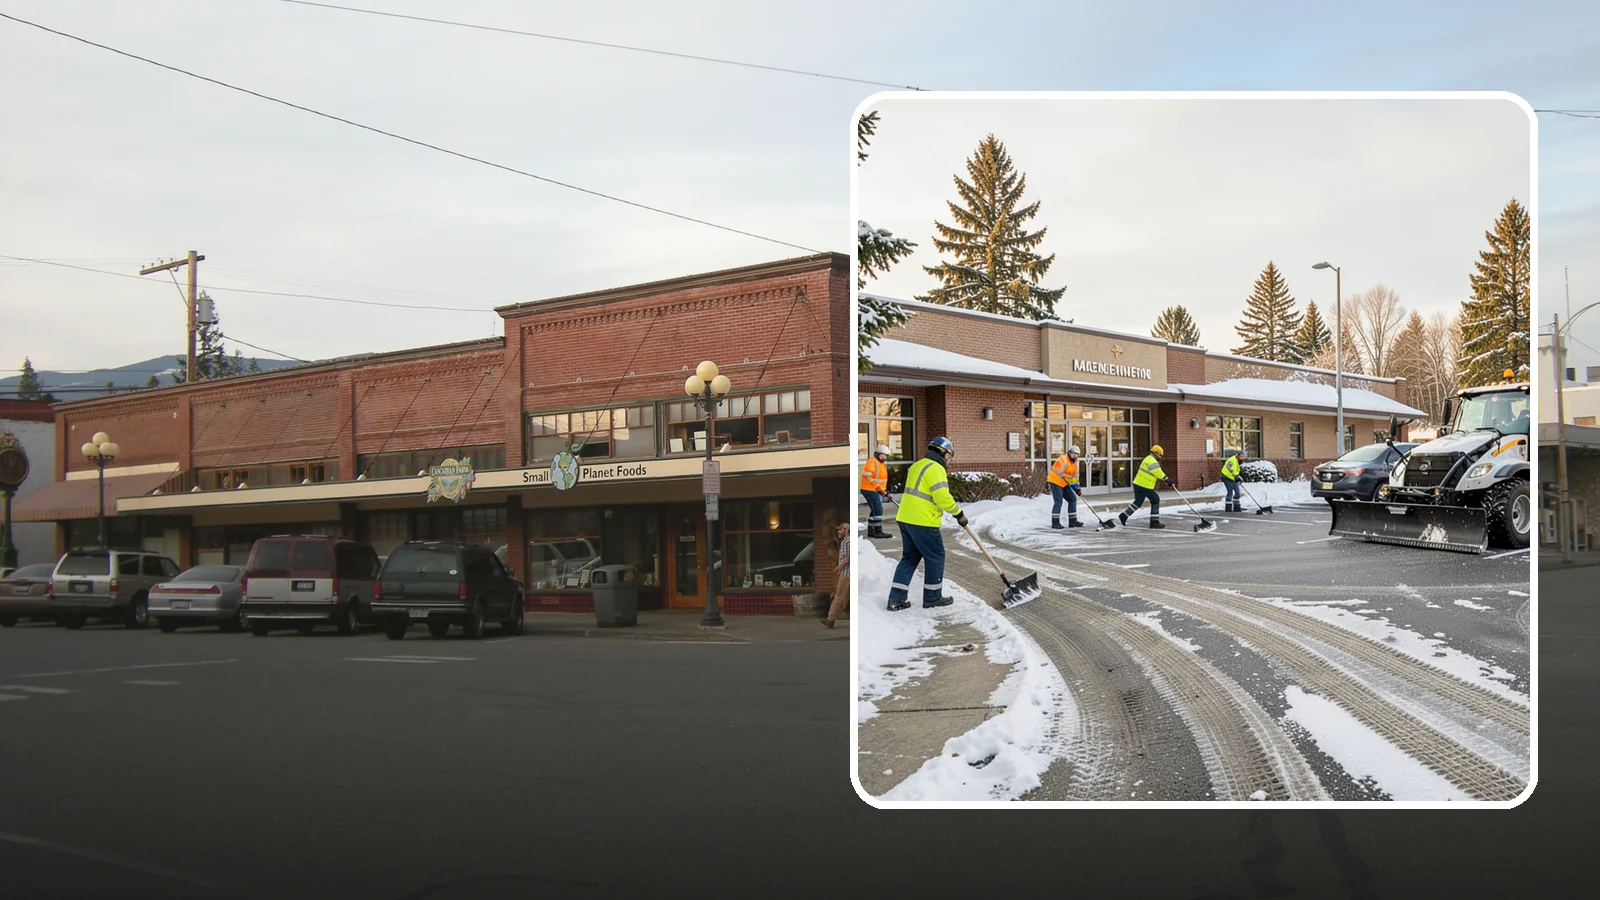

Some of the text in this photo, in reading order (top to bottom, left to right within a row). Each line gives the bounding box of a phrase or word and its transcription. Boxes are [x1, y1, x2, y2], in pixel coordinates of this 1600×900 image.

[523, 464, 647, 483] Small Planet Foods
